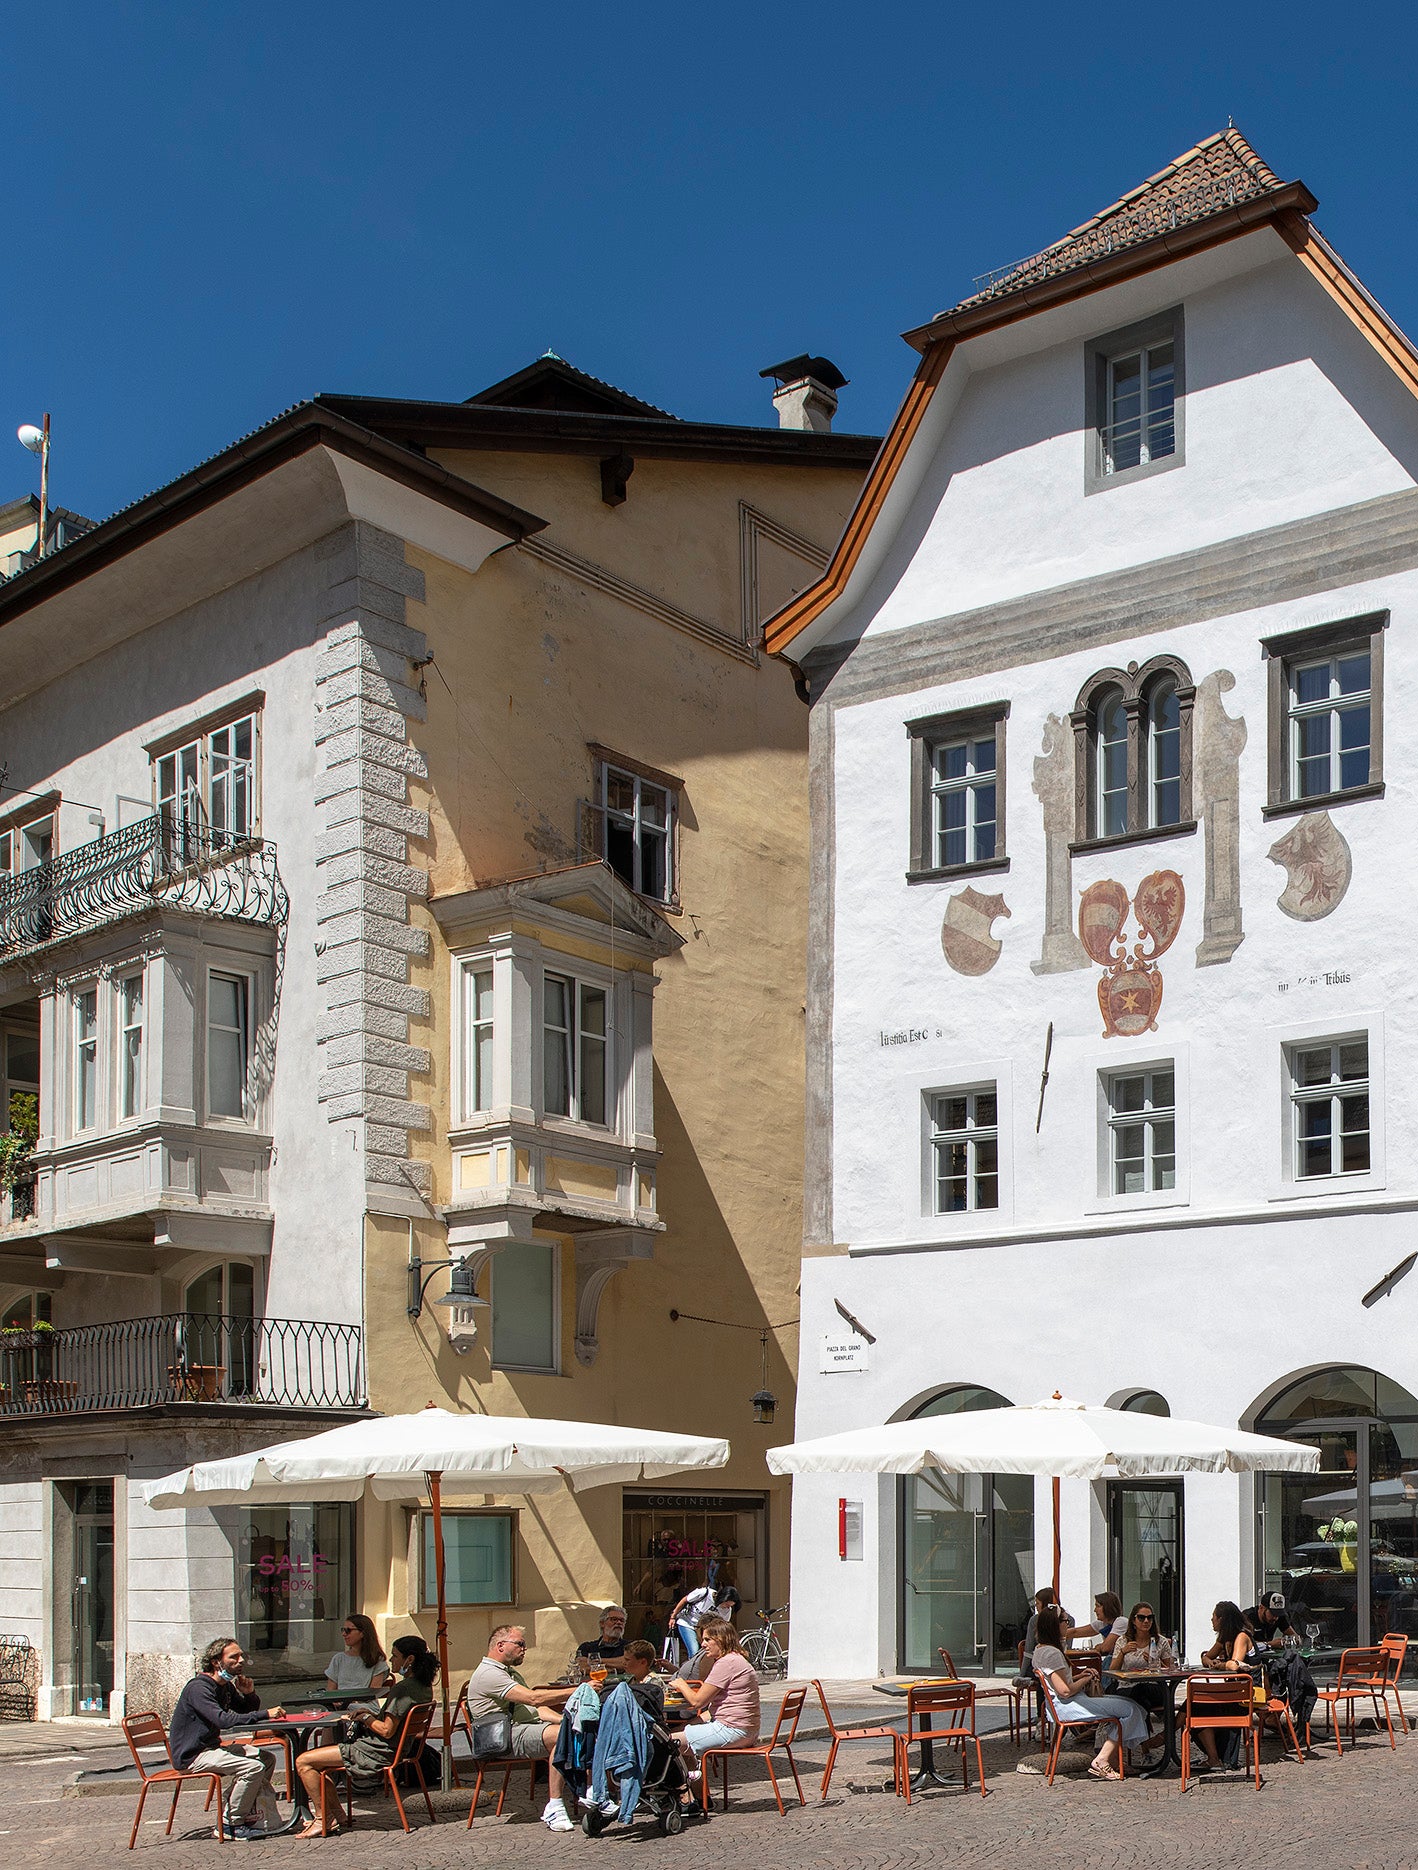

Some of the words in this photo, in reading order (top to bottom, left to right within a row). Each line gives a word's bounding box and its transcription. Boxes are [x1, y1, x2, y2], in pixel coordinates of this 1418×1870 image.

[647, 1495, 725, 1506] COCCINELLE
[668, 1539, 713, 1557] SALE
[259, 1553, 328, 1575] SALE
[281, 1579, 314, 1592] 50%
